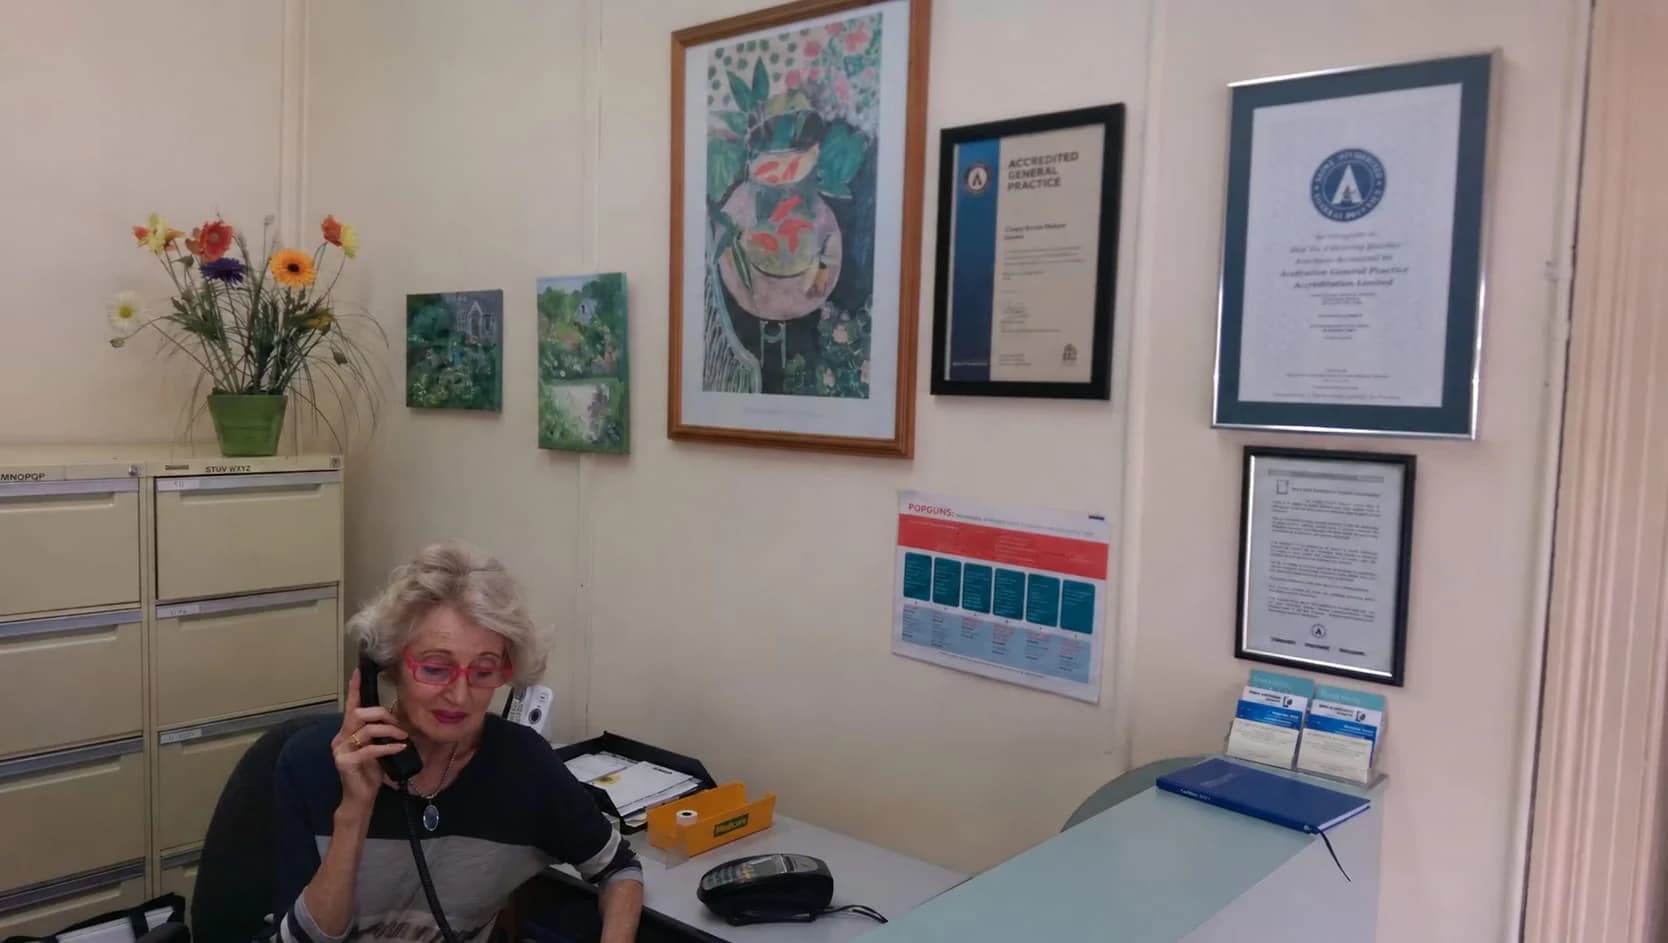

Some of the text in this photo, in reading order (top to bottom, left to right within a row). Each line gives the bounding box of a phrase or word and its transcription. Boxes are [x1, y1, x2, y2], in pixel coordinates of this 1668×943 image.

[1008, 151, 1079, 167] ACCREDITED
[1008, 167, 1058, 180] GENERAL
[1007, 177, 1061, 191] PRACTICE
[205, 465, 227, 473] STUV
[908, 502, 955, 517] POPGUNS:
